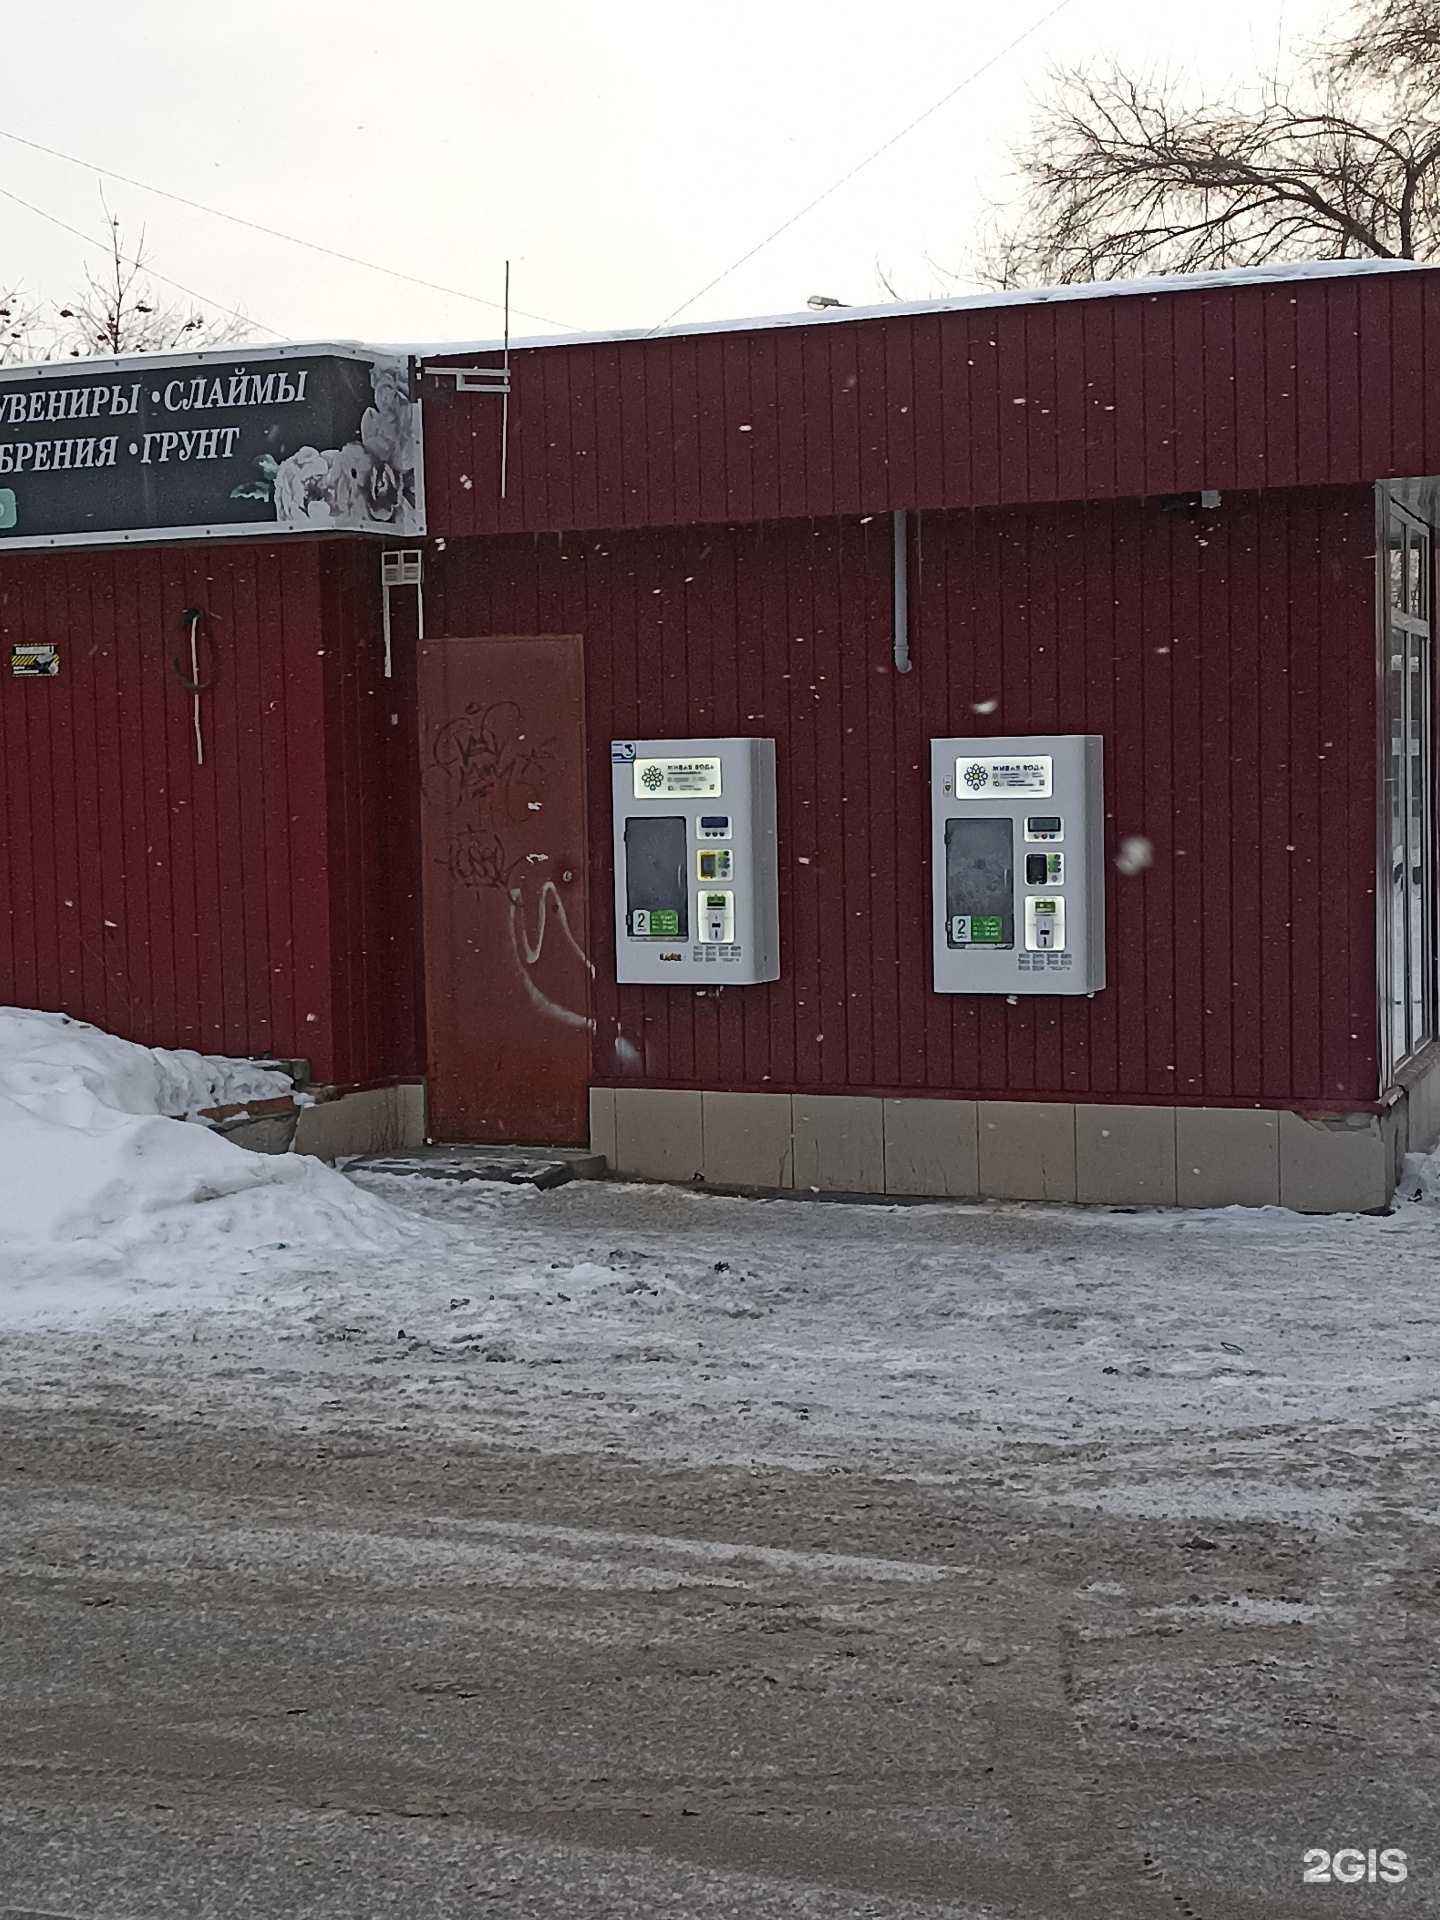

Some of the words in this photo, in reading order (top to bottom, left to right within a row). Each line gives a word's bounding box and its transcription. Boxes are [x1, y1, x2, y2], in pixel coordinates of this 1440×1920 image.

[164, 368, 308, 411] СЛАЙМЫ
[140, 427, 240, 464] ГРУНТ
[637, 912, 645, 928] 2
[957, 918, 966, 935] 2
